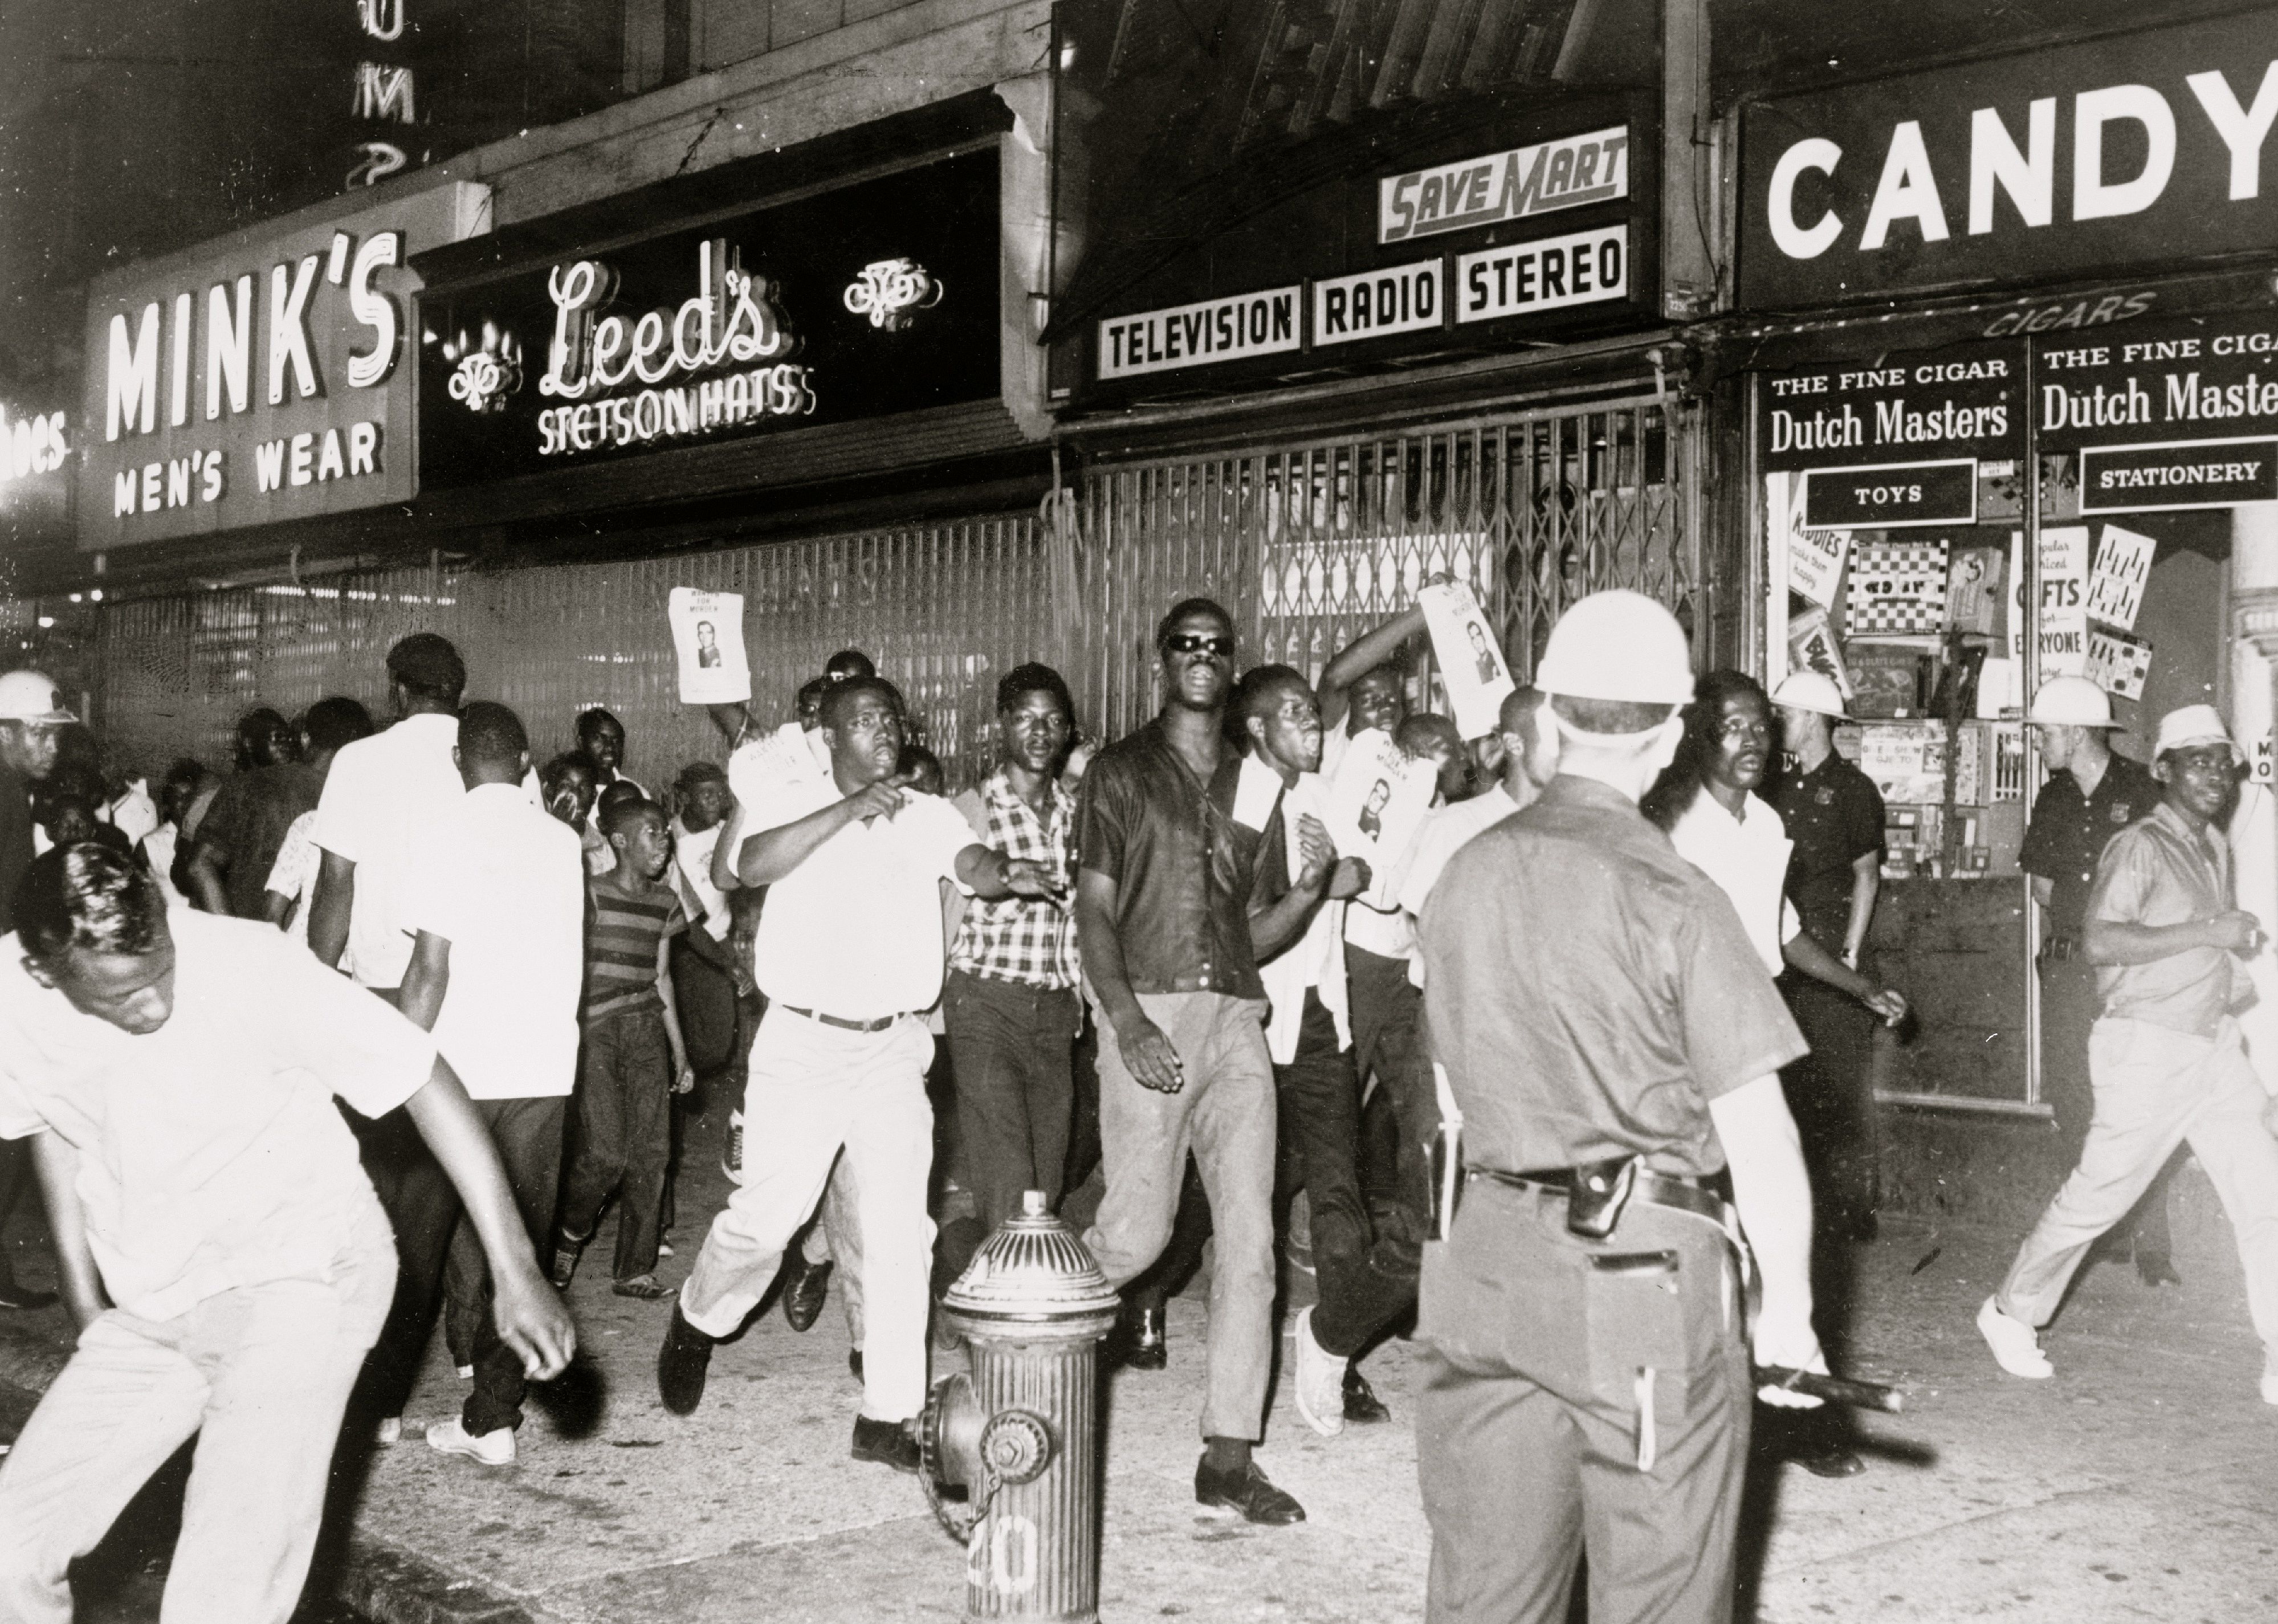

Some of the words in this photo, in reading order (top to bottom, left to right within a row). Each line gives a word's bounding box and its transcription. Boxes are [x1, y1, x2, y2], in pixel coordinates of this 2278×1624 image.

[1768, 59, 2278, 259] CANDY
[1325, 271, 1435, 334] RADIO
[1469, 238, 1620, 311] STEREO
[105, 232, 397, 442] MINK'S
[539, 239, 781, 397] Leed's
[1109, 294, 1292, 369] TELEVISION
[1983, 291, 2157, 337] CIGARS
[1772, 376, 1828, 396] THE
[1840, 368, 1905, 390] FINE
[1915, 360, 2008, 384] CIGAR
[2044, 346, 2110, 369] THE
[2123, 338, 2200, 363] FINE
[538, 387, 691, 455] STETSON
[1771, 404, 1863, 452] Dutch
[1874, 399, 2008, 444] Masters
[2042, 377, 2151, 431] Dutch
[115, 449, 222, 518] MEN'S
[255, 422, 376, 493] WEAR
[1855, 485, 1922, 505] TOYS
[2100, 462, 2261, 489] STATIONERY
